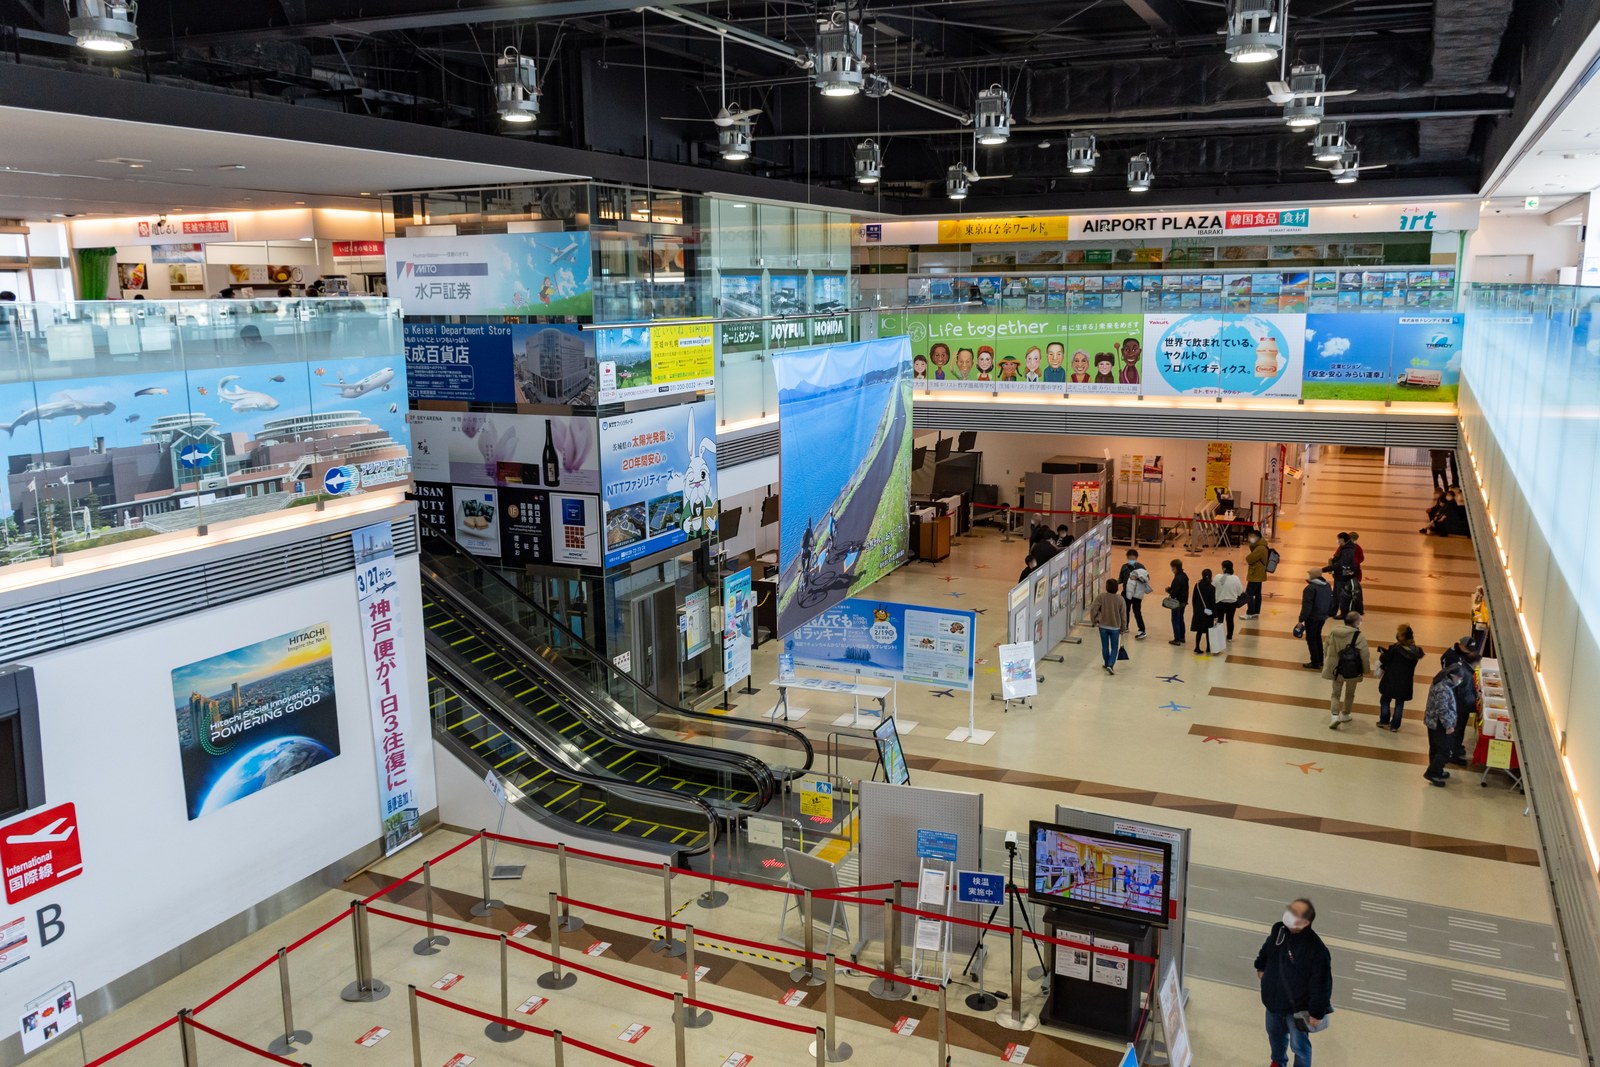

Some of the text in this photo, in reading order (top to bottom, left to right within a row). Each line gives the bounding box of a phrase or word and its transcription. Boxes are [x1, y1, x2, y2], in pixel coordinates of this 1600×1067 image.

[1083, 216, 1223, 233] AIRPORT PLAZA
[1231, 212, 1307, 226] 韓国食品 食材
[416, 264, 437, 274] MITO
[415, 282, 472, 300] 水戸証券
[412, 325, 437, 335] Keisei
[441, 325, 484, 337] Department
[488, 325, 512, 336] Store
[771, 322, 806, 340] JOYFUL
[815, 320, 844, 336] HONDA
[928, 322, 963, 338] Life
[723, 331, 760, 345] ホームセンター
[1165, 337, 1254, 348] 世界で飲まれている、
[1164, 351, 1208, 360] ヤクルトの
[1164, 364, 1252, 375] プロバイオティクス。
[289, 628, 325, 645] HITACHI
[370, 599, 408, 791] 神戸便が1日3往復に
[210, 685, 320, 730] Hitachi Social Innovation is
[211, 694, 321, 742] POWERING GOOD
[6, 850, 53, 877] International
[9, 863, 54, 893] 国際線
[973, 877, 989, 887] 検温
[968, 887, 994, 897] 実施中
[36, 903, 65, 948] B
